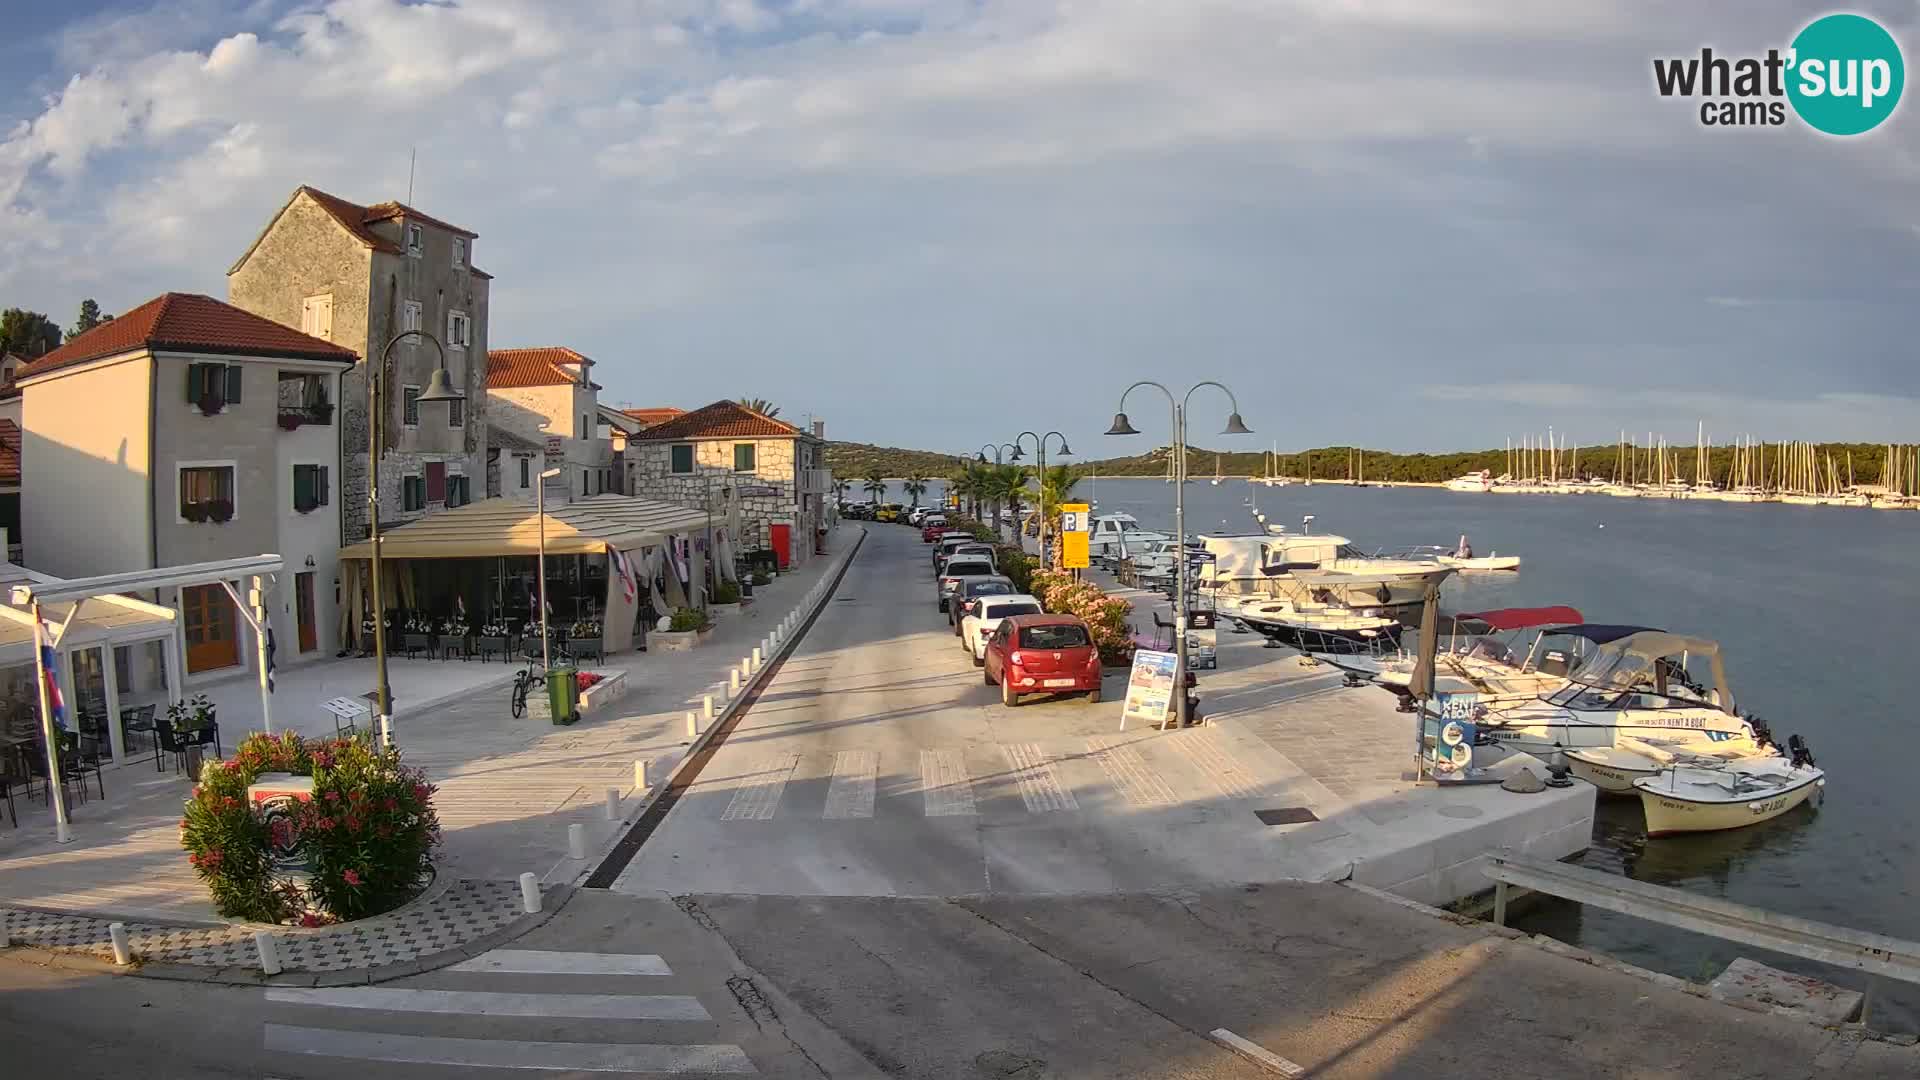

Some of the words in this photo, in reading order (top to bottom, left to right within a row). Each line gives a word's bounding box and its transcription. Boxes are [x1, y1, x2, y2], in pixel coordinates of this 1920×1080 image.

[1065, 513, 1076, 530] P
[1443, 699, 1474, 710] RENT
[1443, 710, 1450, 720] A
[1451, 709, 1474, 720] BOAT
[1667, 718, 1684, 727] RENT
[1685, 718, 1690, 727] A
[1691, 718, 1707, 728] BOAT
